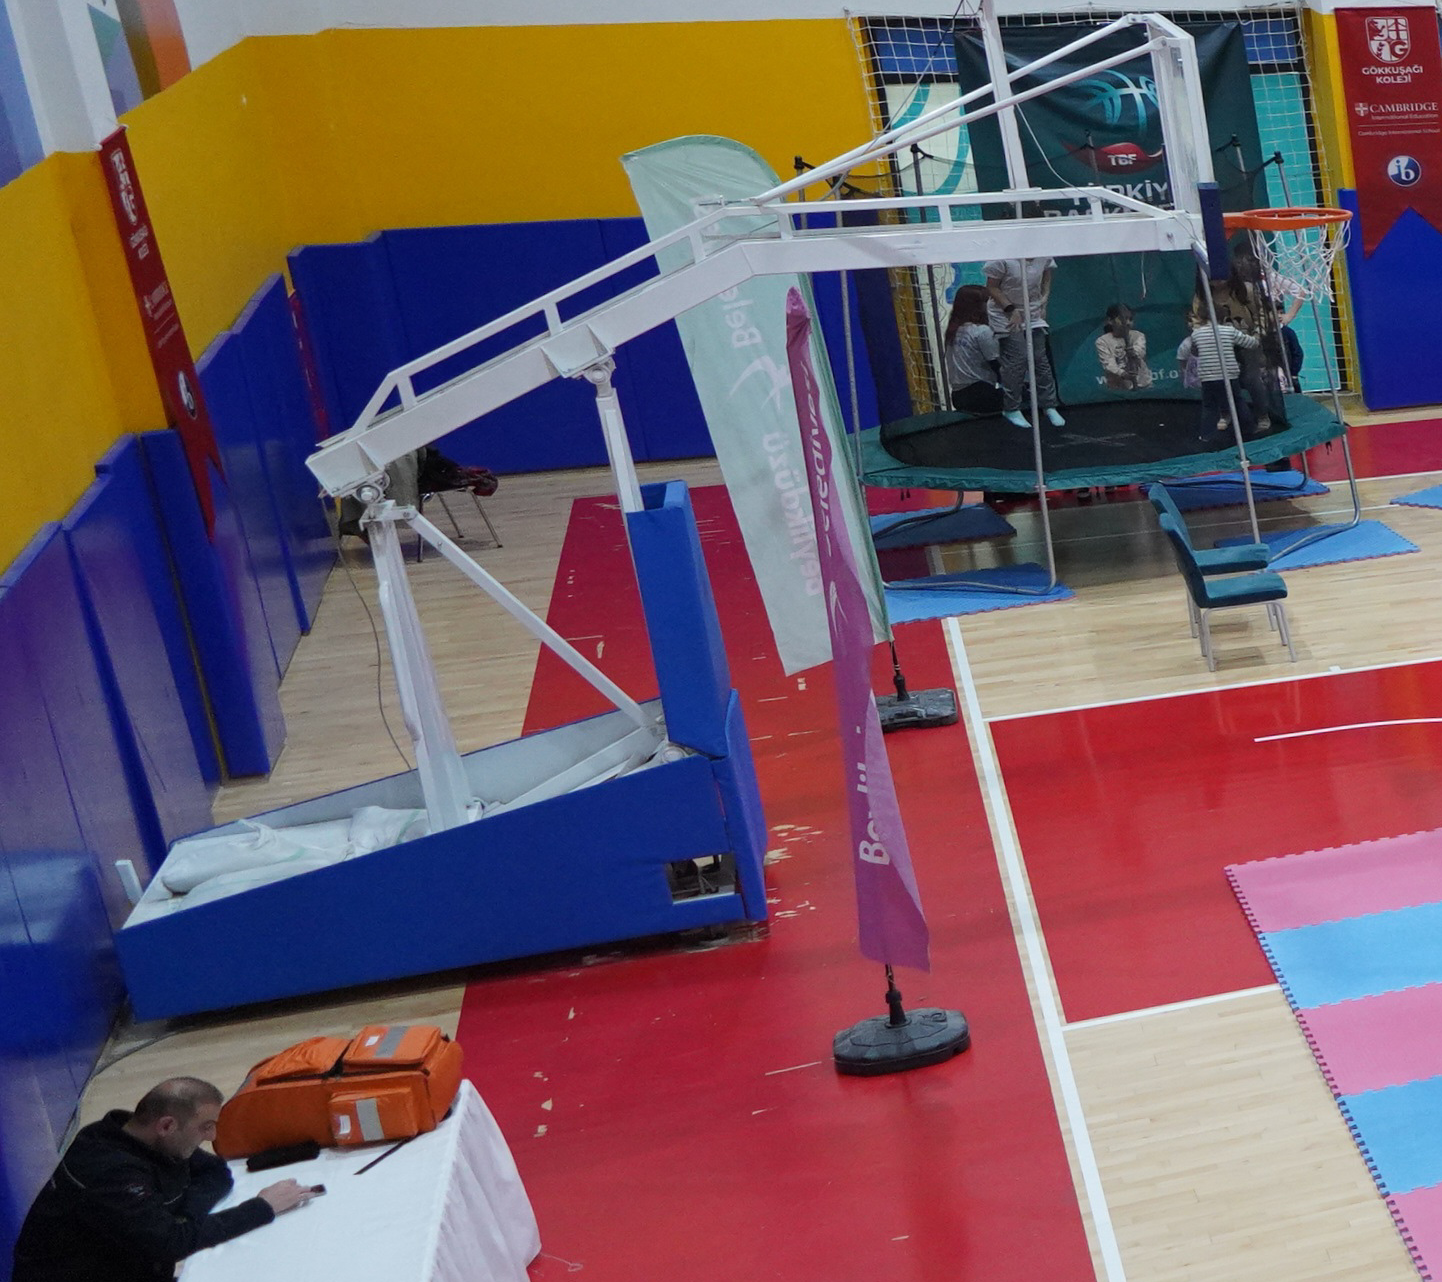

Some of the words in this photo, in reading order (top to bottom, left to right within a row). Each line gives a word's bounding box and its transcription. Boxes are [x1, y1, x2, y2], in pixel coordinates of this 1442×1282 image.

[1362, 65, 1423, 75] GÖKKUŞAĞI
[1376, 74, 1411, 84] KOLEJİ
[1370, 103, 1438, 113] CAMBRIDGE
[1108, 154, 1137, 166] TBF
